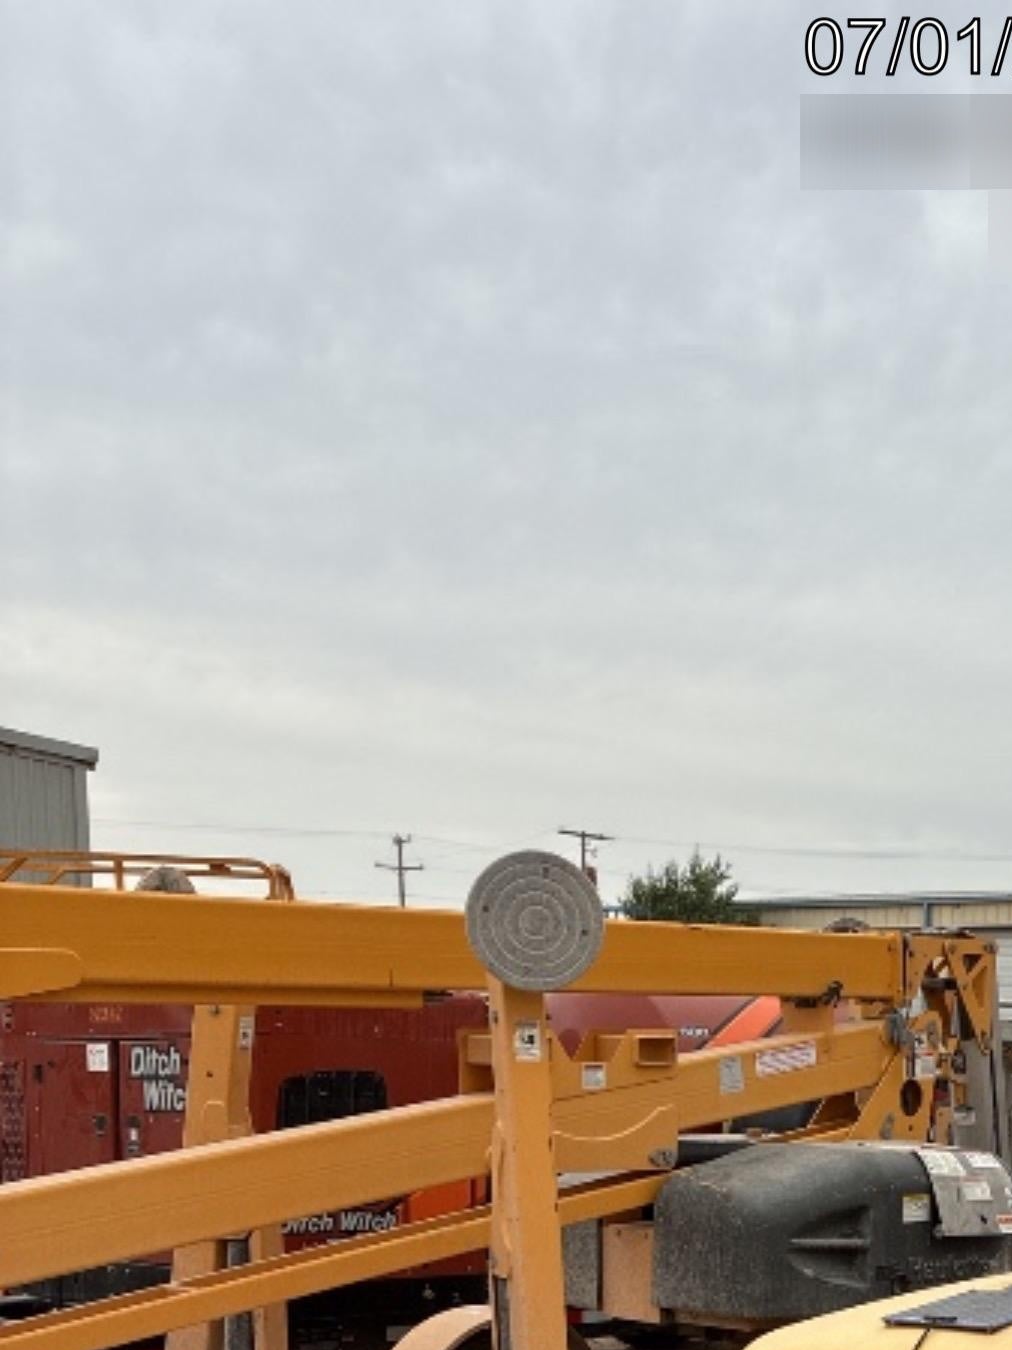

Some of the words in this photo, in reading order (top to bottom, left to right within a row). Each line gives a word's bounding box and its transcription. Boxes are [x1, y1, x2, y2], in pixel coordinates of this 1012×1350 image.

[130, 1046, 181, 1077] Ditch
[143, 1080, 188, 1111] Witc
[341, 1210, 396, 1232] Witch
